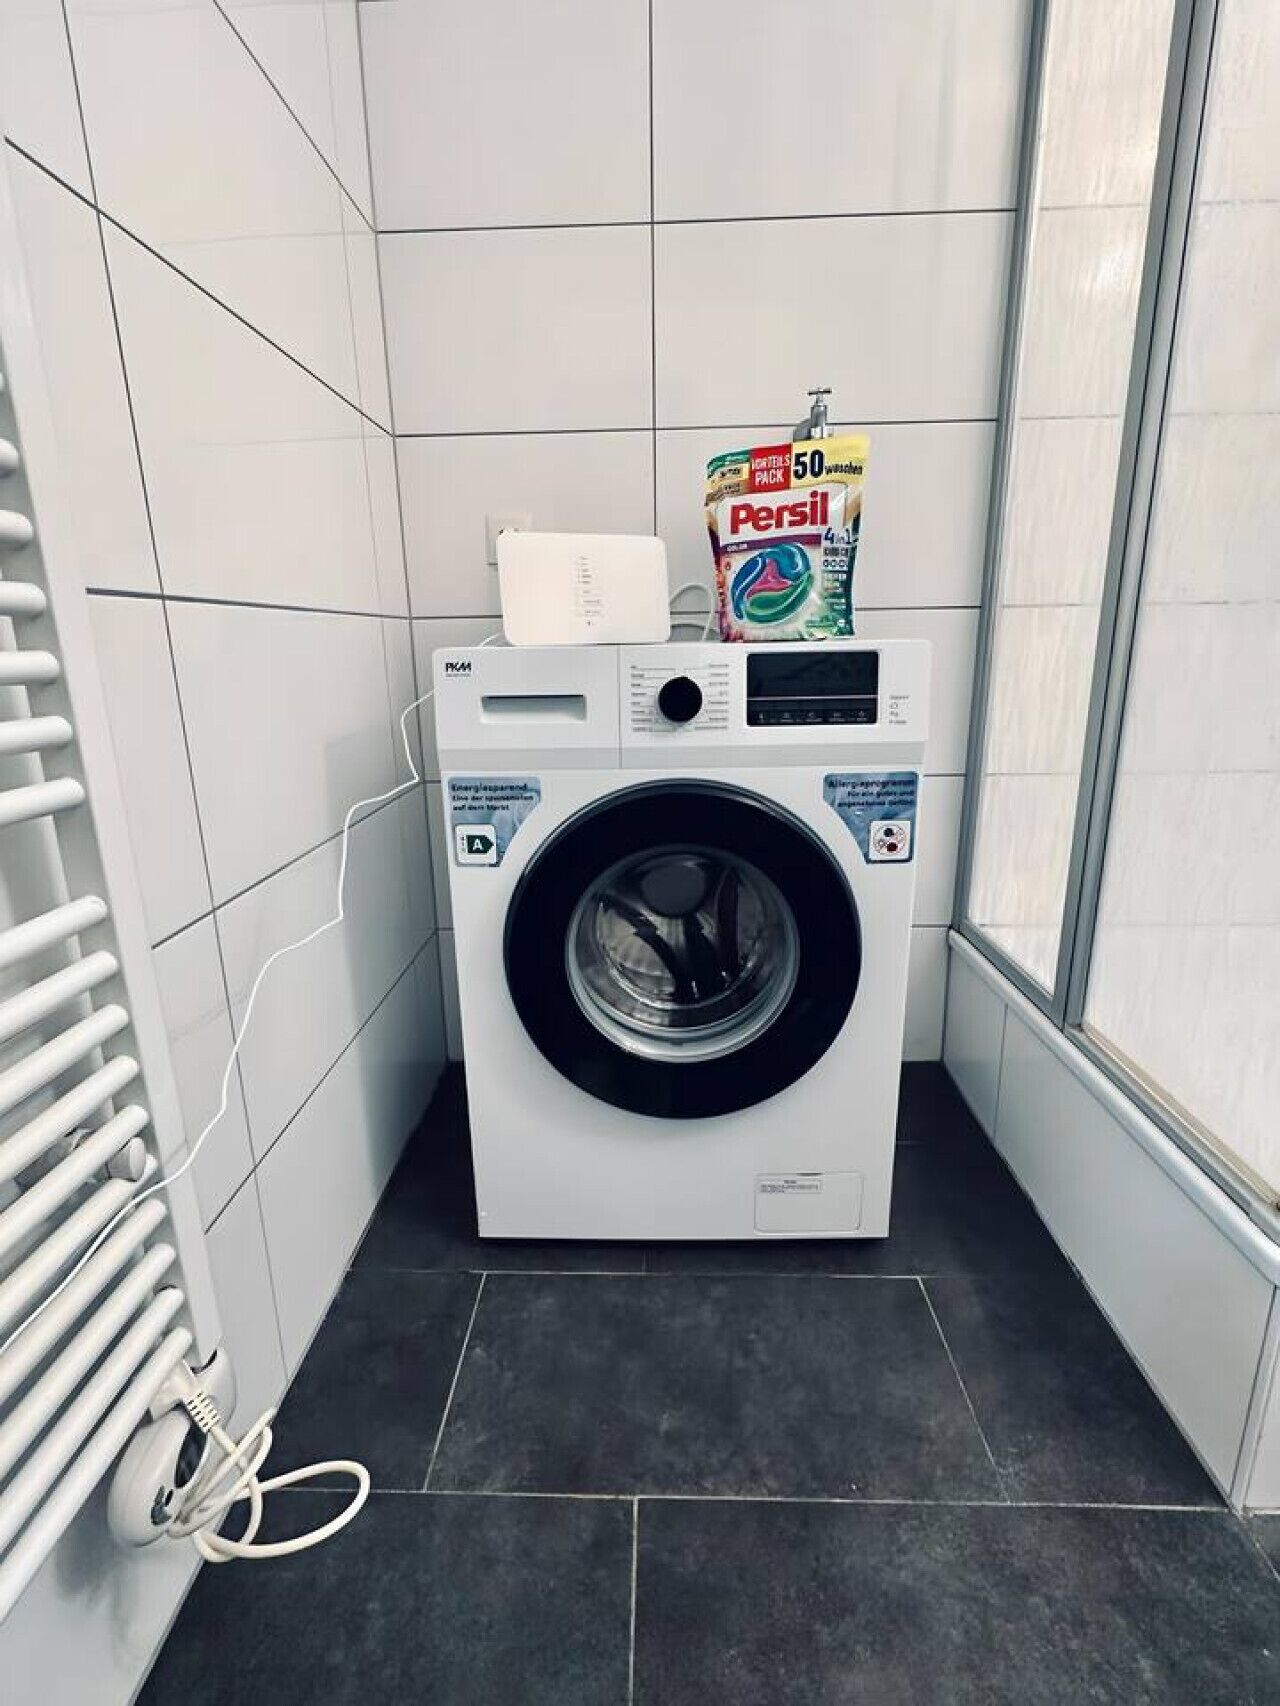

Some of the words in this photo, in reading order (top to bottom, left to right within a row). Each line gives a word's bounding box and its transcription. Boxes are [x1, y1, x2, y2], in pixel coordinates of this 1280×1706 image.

[793, 449, 824, 480] 50
[755, 469, 784, 486] PACK
[730, 490, 829, 535] Persil
[452, 783, 527, 793] Energiesparend
[472, 838, 485, 851] A
